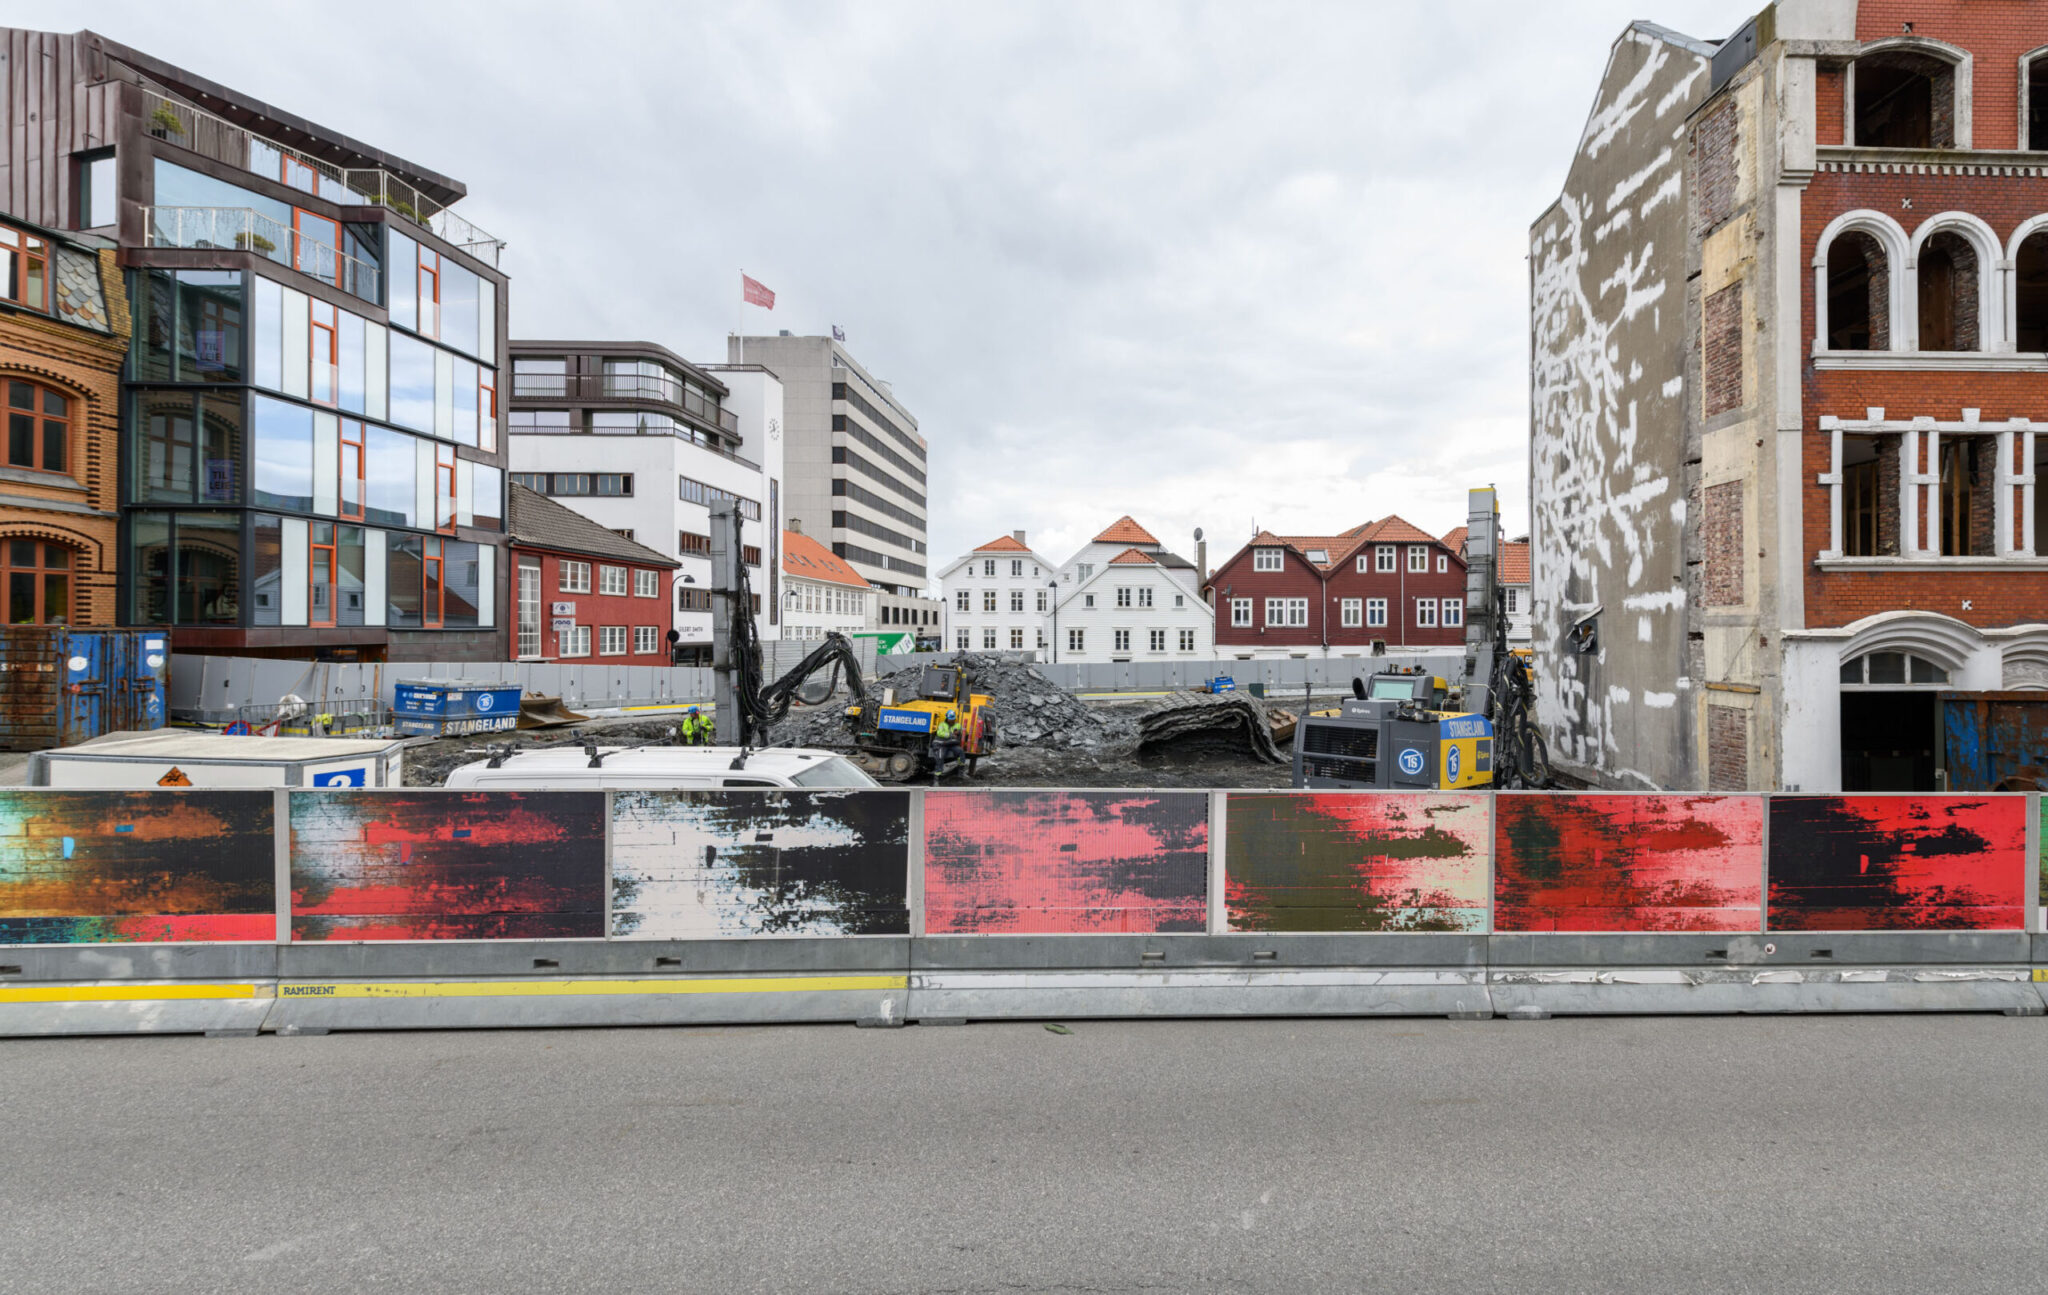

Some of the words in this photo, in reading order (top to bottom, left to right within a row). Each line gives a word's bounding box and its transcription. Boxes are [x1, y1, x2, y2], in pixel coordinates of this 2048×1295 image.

[212, 471, 228, 479] TIL
[209, 481, 231, 489] LEIE
[402, 721, 435, 730] STANGELAND
[883, 714, 927, 726] STANGELAND
[446, 717, 516, 735] STANGELAND
[1448, 720, 1485, 737] STANGELAND
[1404, 752, 1420, 769] TS
[283, 986, 336, 996] RAMIRENT
